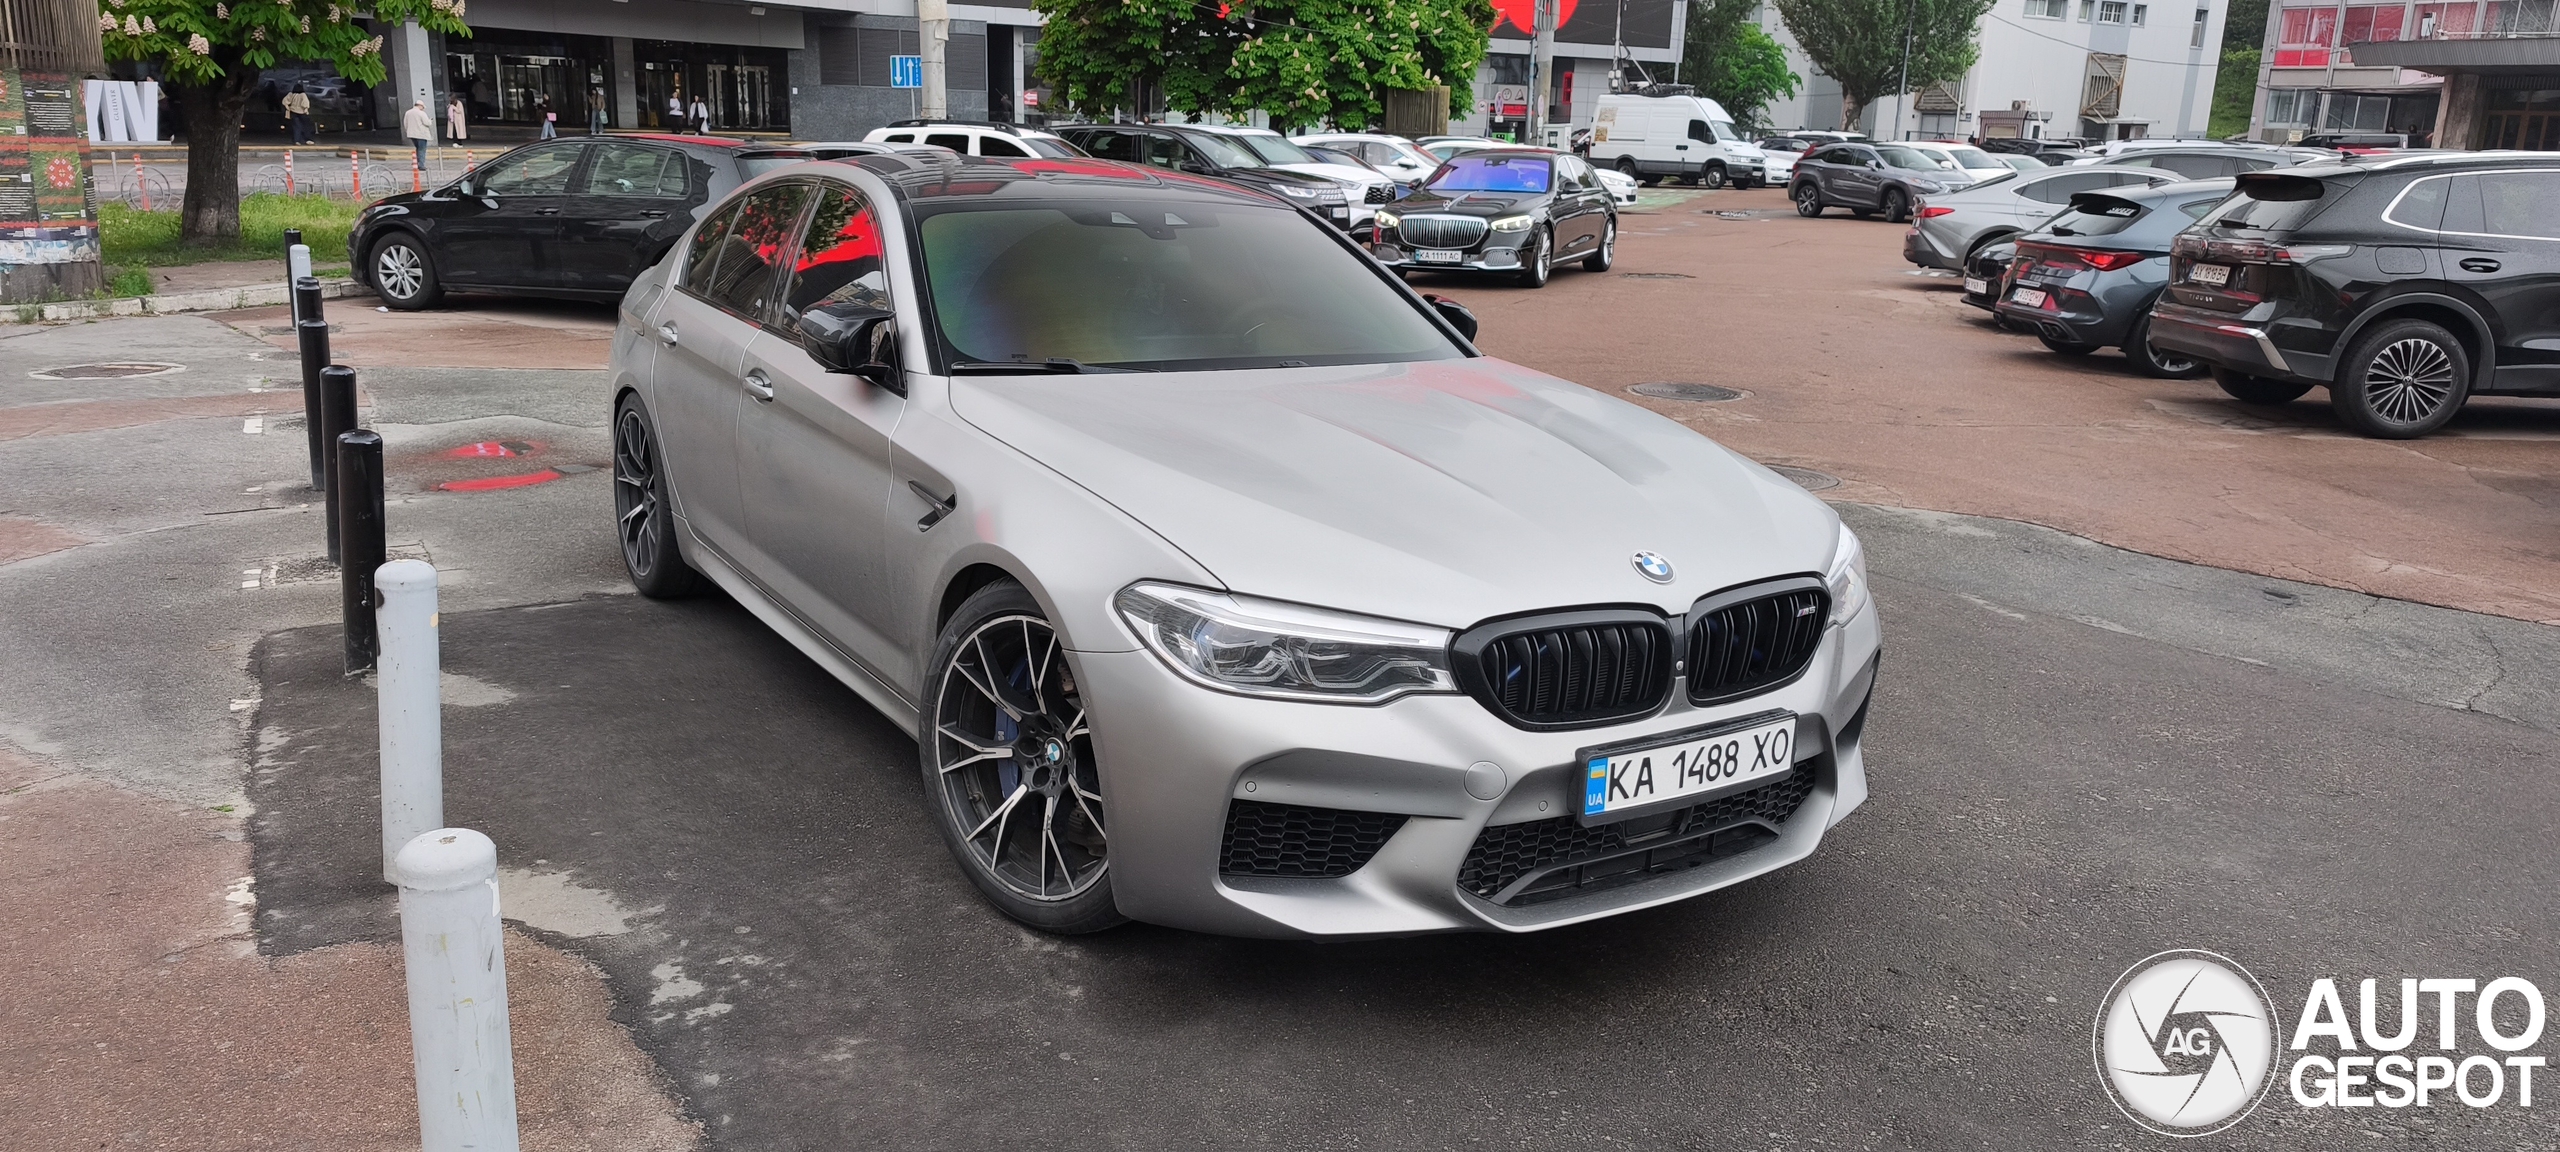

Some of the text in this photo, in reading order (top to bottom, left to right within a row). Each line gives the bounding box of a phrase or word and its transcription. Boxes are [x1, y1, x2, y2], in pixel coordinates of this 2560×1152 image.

[1608, 727, 1789, 802] KA 1488 XO
[1588, 792, 1603, 806] UA
